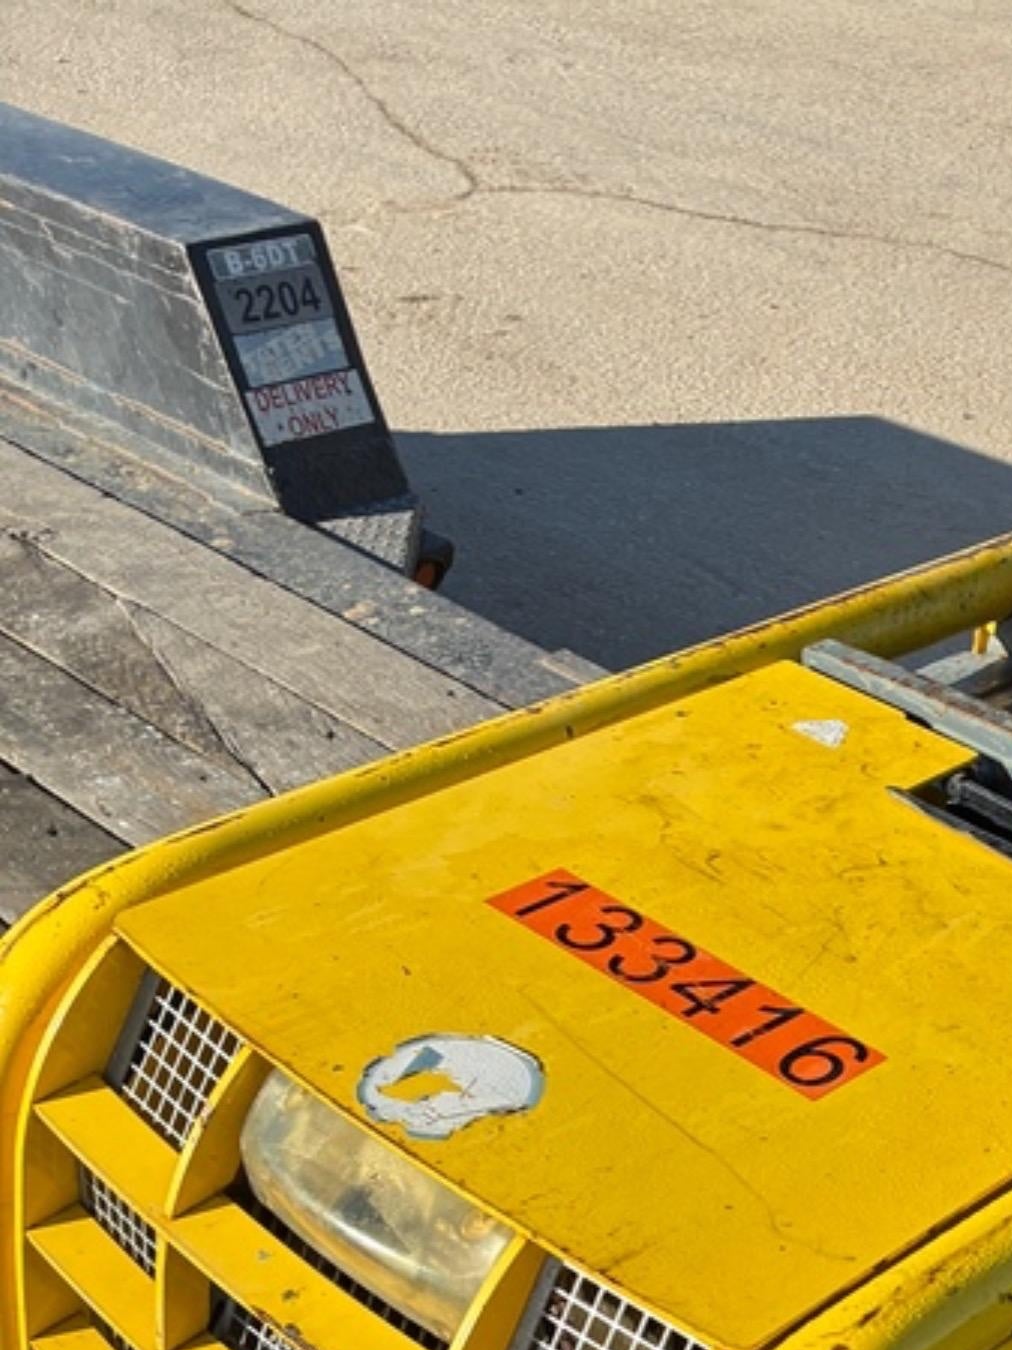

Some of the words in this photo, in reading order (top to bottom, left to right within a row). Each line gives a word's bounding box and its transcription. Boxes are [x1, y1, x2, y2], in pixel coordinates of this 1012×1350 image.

[235, 278, 321, 322] 2204
[252, 373, 350, 413] DELIVERY
[287, 406, 340, 436] ONLY
[514, 880, 869, 1087] 133416
